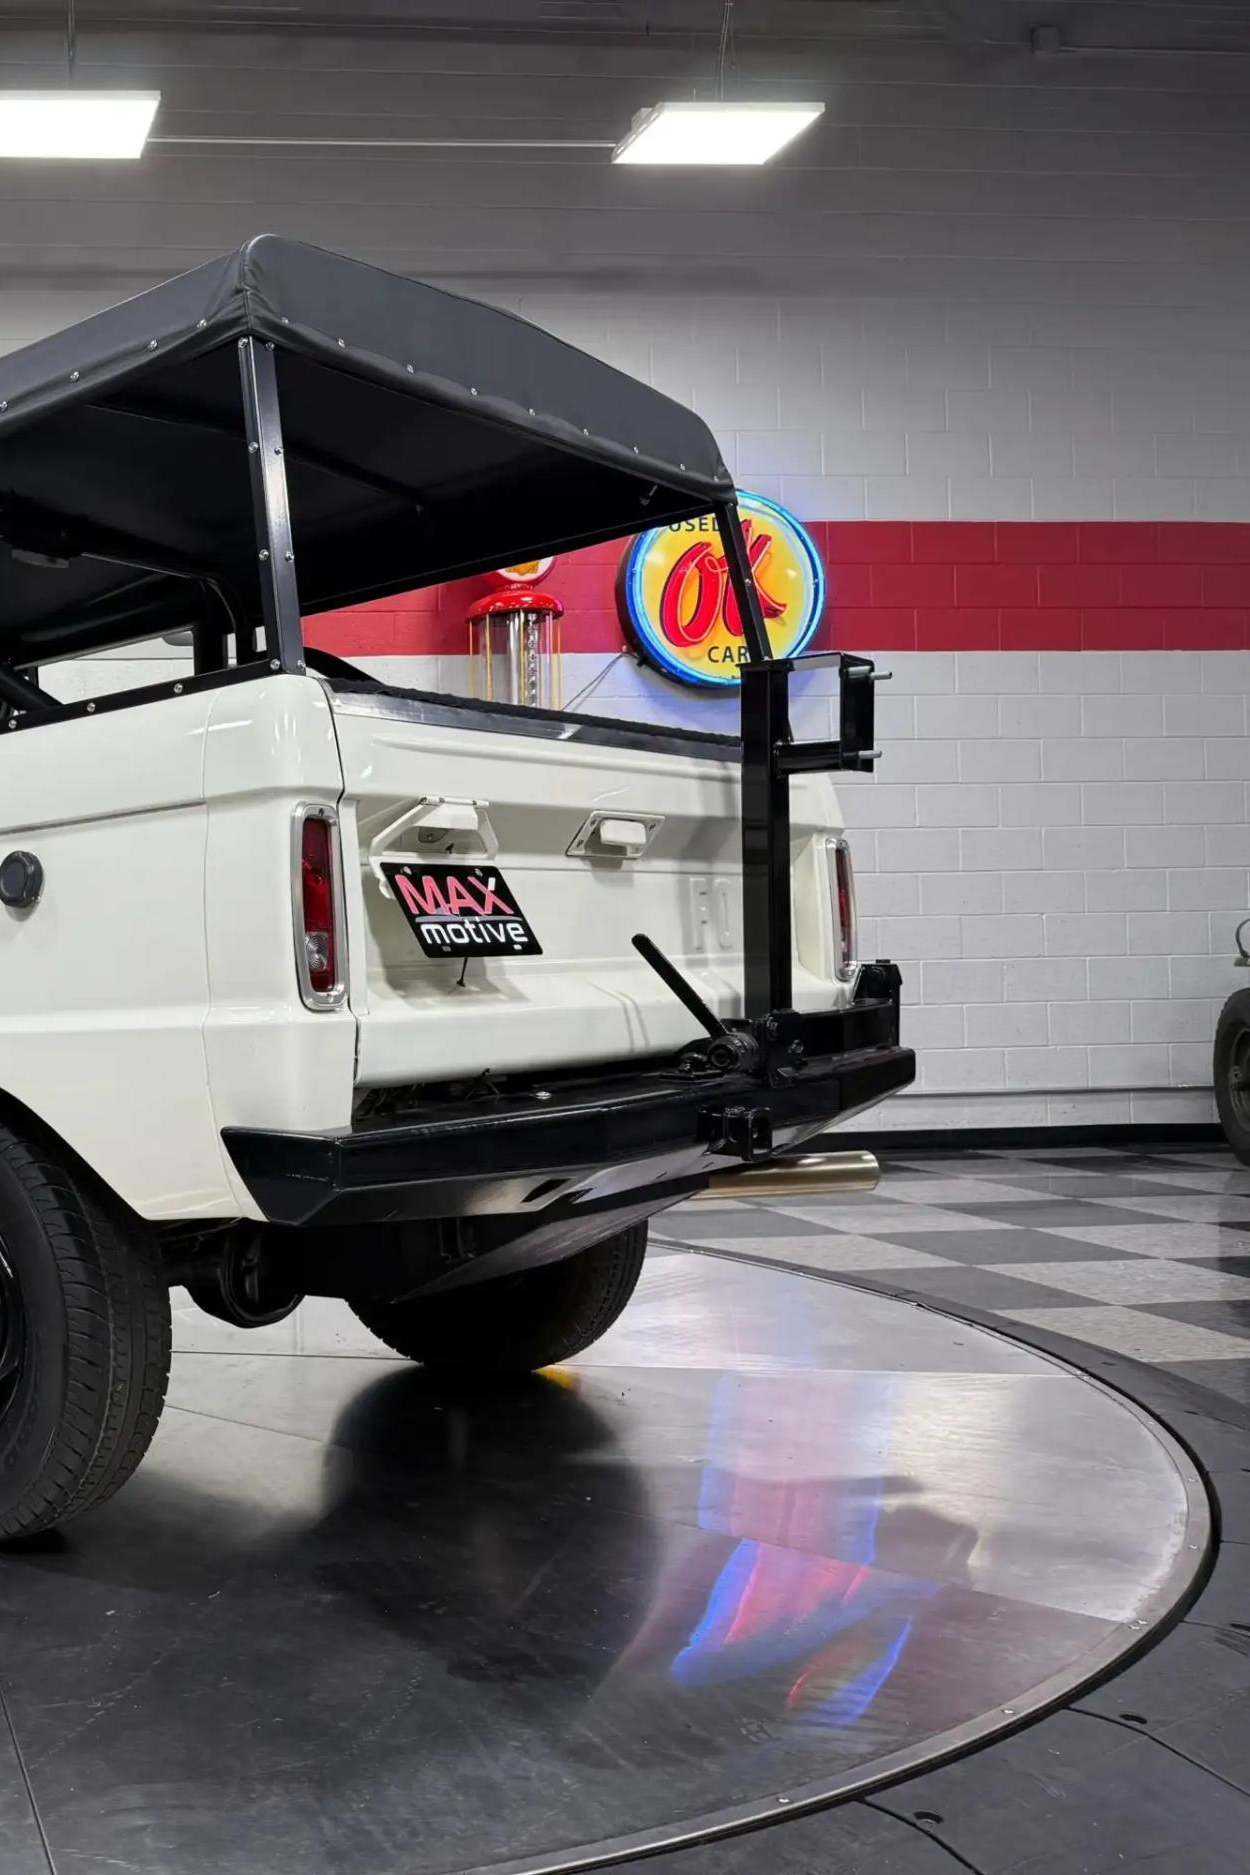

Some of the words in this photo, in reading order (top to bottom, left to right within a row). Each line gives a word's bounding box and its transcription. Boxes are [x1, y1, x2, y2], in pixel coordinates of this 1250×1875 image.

[659, 519, 788, 647] OK
[707, 645, 751, 663] CAR
[394, 874, 515, 916] MAX
[688, 877, 735, 952] FO
[420, 916, 529, 945] motive
